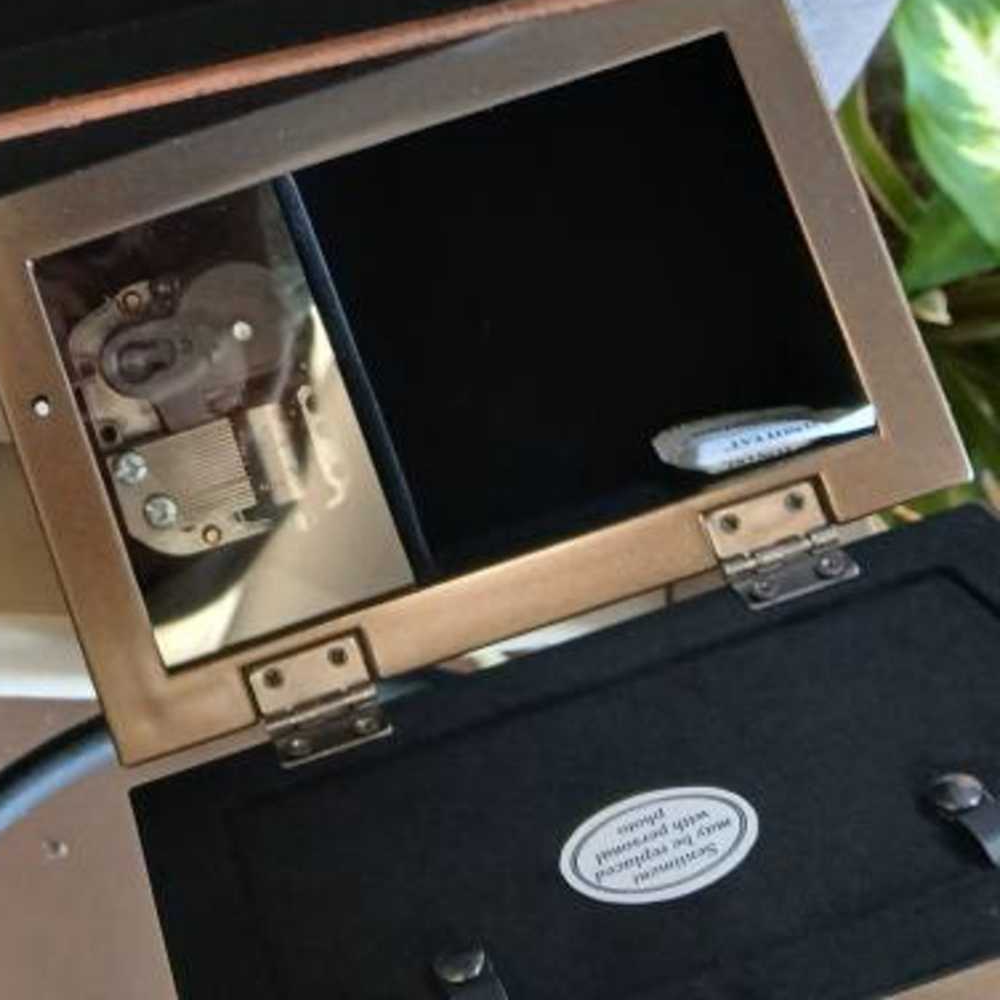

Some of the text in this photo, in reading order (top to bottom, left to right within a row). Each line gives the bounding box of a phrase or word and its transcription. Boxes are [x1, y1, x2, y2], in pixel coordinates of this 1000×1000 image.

[595, 810, 709, 866] with personal
[617, 808, 665, 834] photo
[696, 818, 731, 837] may
[595, 844, 668, 881] replaced
[634, 843, 719, 884] Sentiment
